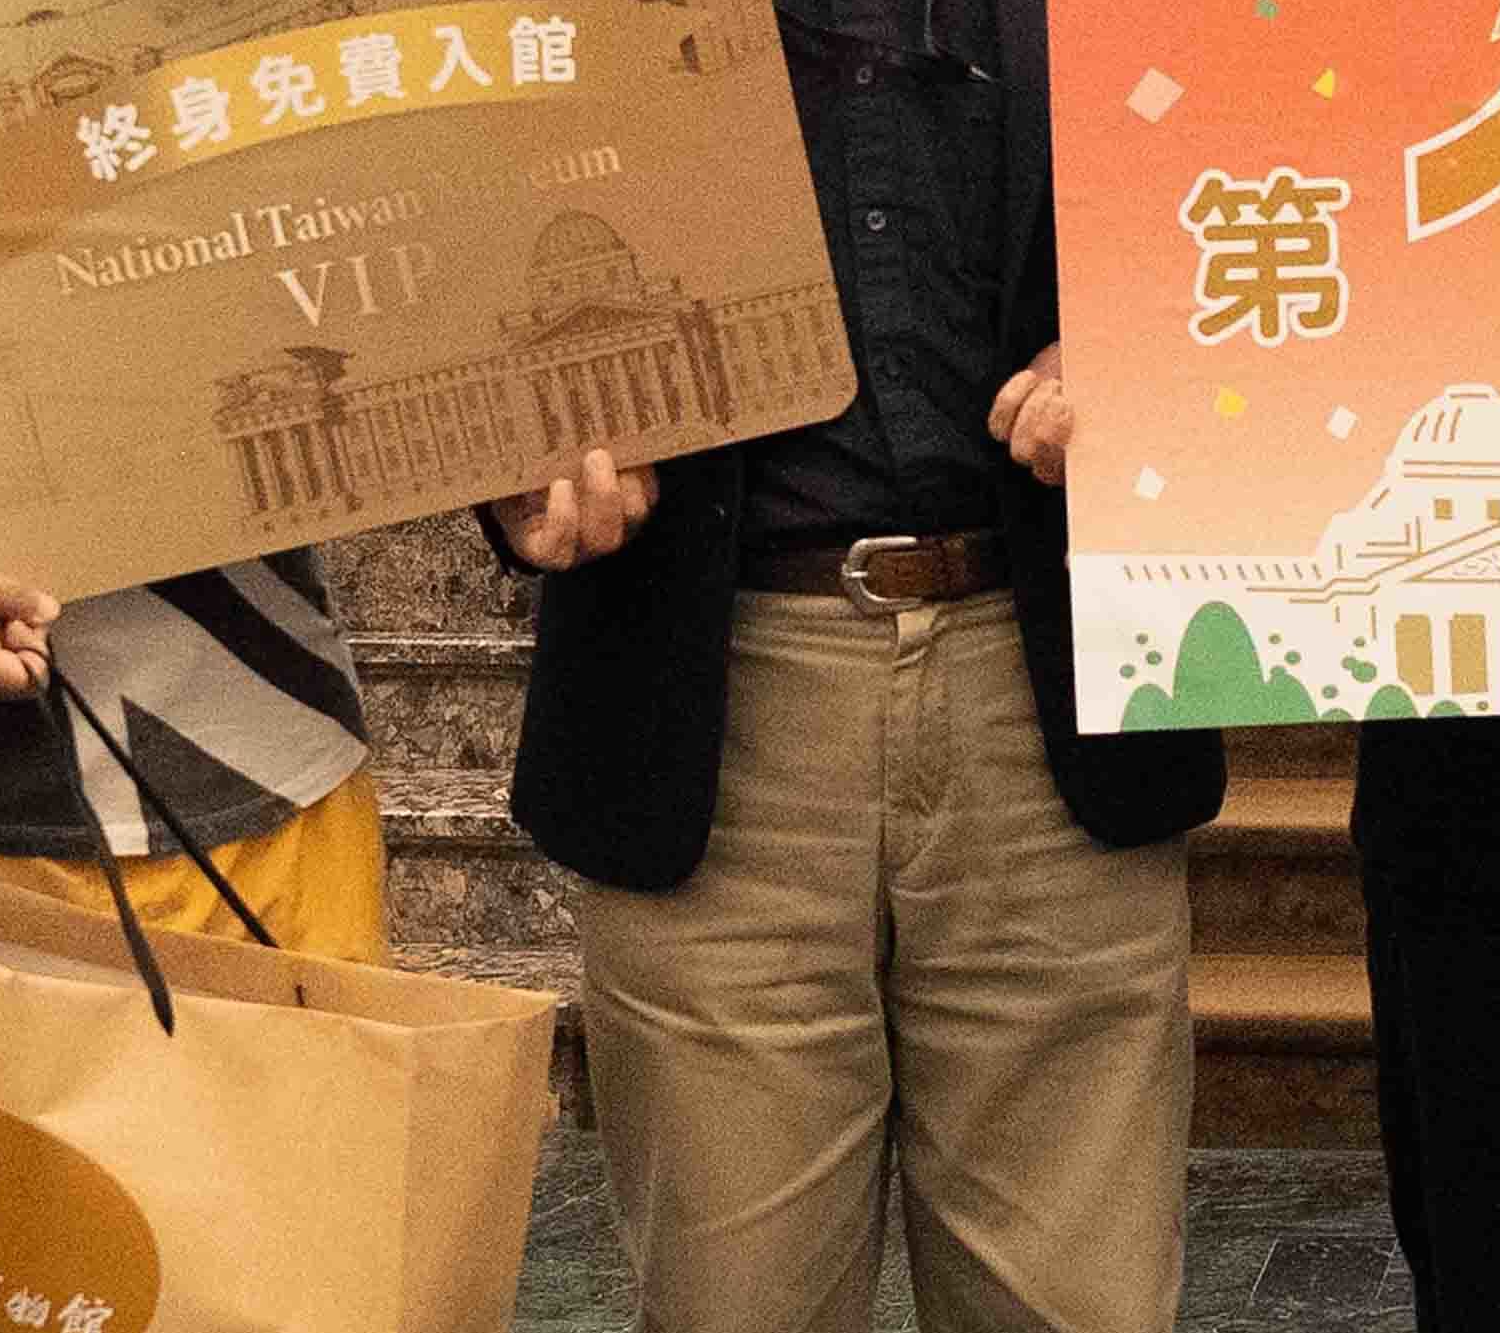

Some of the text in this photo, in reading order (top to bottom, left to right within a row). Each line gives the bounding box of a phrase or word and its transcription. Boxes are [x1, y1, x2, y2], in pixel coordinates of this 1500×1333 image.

[77, 16, 578, 182] 終身免費入館
[56, 211, 254, 295] National
[256, 190, 427, 249] Taiwan
[277, 242, 437, 328] VIP
